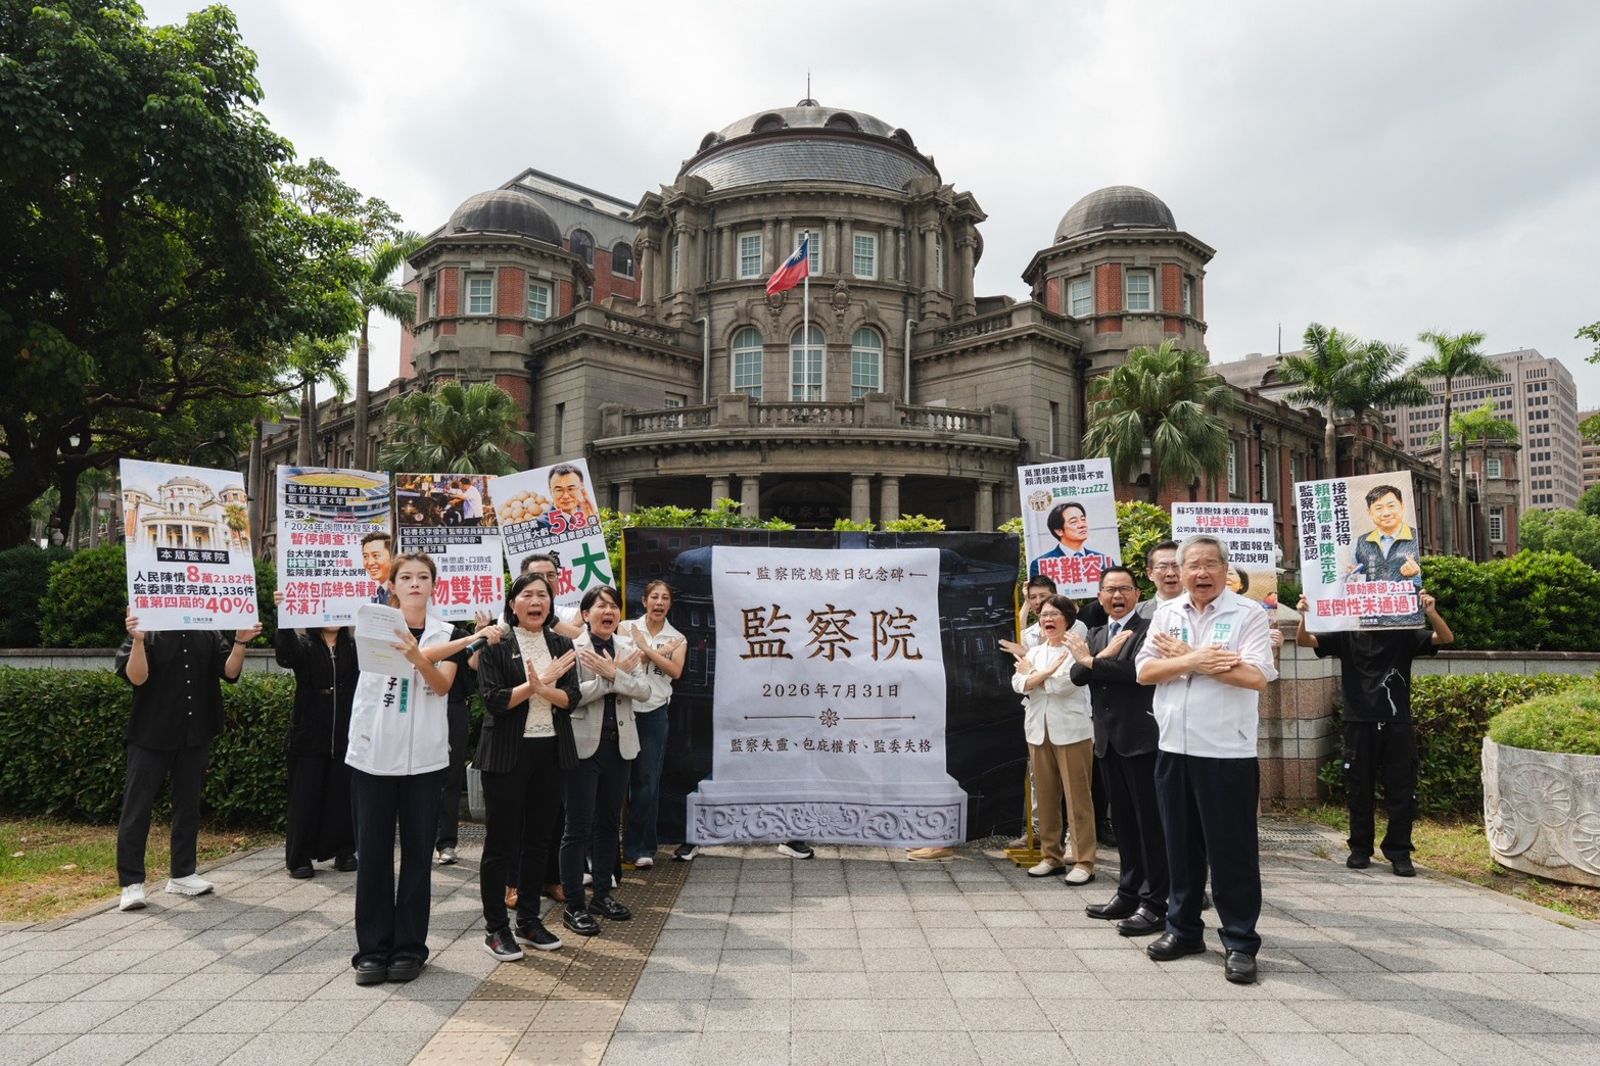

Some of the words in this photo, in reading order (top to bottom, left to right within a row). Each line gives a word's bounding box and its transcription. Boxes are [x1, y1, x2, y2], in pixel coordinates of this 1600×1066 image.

[1024, 463, 1085, 477] 萬里賴皮寮違建
[1024, 470, 1104, 486] 賴清德財產申報不實
[288, 485, 358, 495] 新竹棒球場弊案
[288, 496, 344, 505] 監察院查4年
[1176, 506, 1269, 516] 蘇巧慧胞妹未依法申報
[1332, 482, 1351, 546] 接受性招待
[1196, 516, 1250, 528] 利益迴避
[1299, 485, 1318, 560] 監察院調查認
[161, 549, 226, 562] 本屆監察院
[286, 549, 349, 558] 台大學倫會認定
[134, 564, 254, 585] 人民陳情8萬2182件
[286, 568, 367, 577] 監院竟要求台大說明
[756, 566, 904, 582] 監察院熄燈日紀念碑
[133, 584, 255, 596] 監委調查完成1,336件
[285, 582, 377, 598] 公然包庇綠色權貴
[134, 596, 255, 614] 僅第四屆的40%
[738, 603, 923, 662] 監察院
[762, 683, 899, 698] 2026年7月31日
[730, 737, 932, 755] 監察失靈、包庇權貴、監委失格
